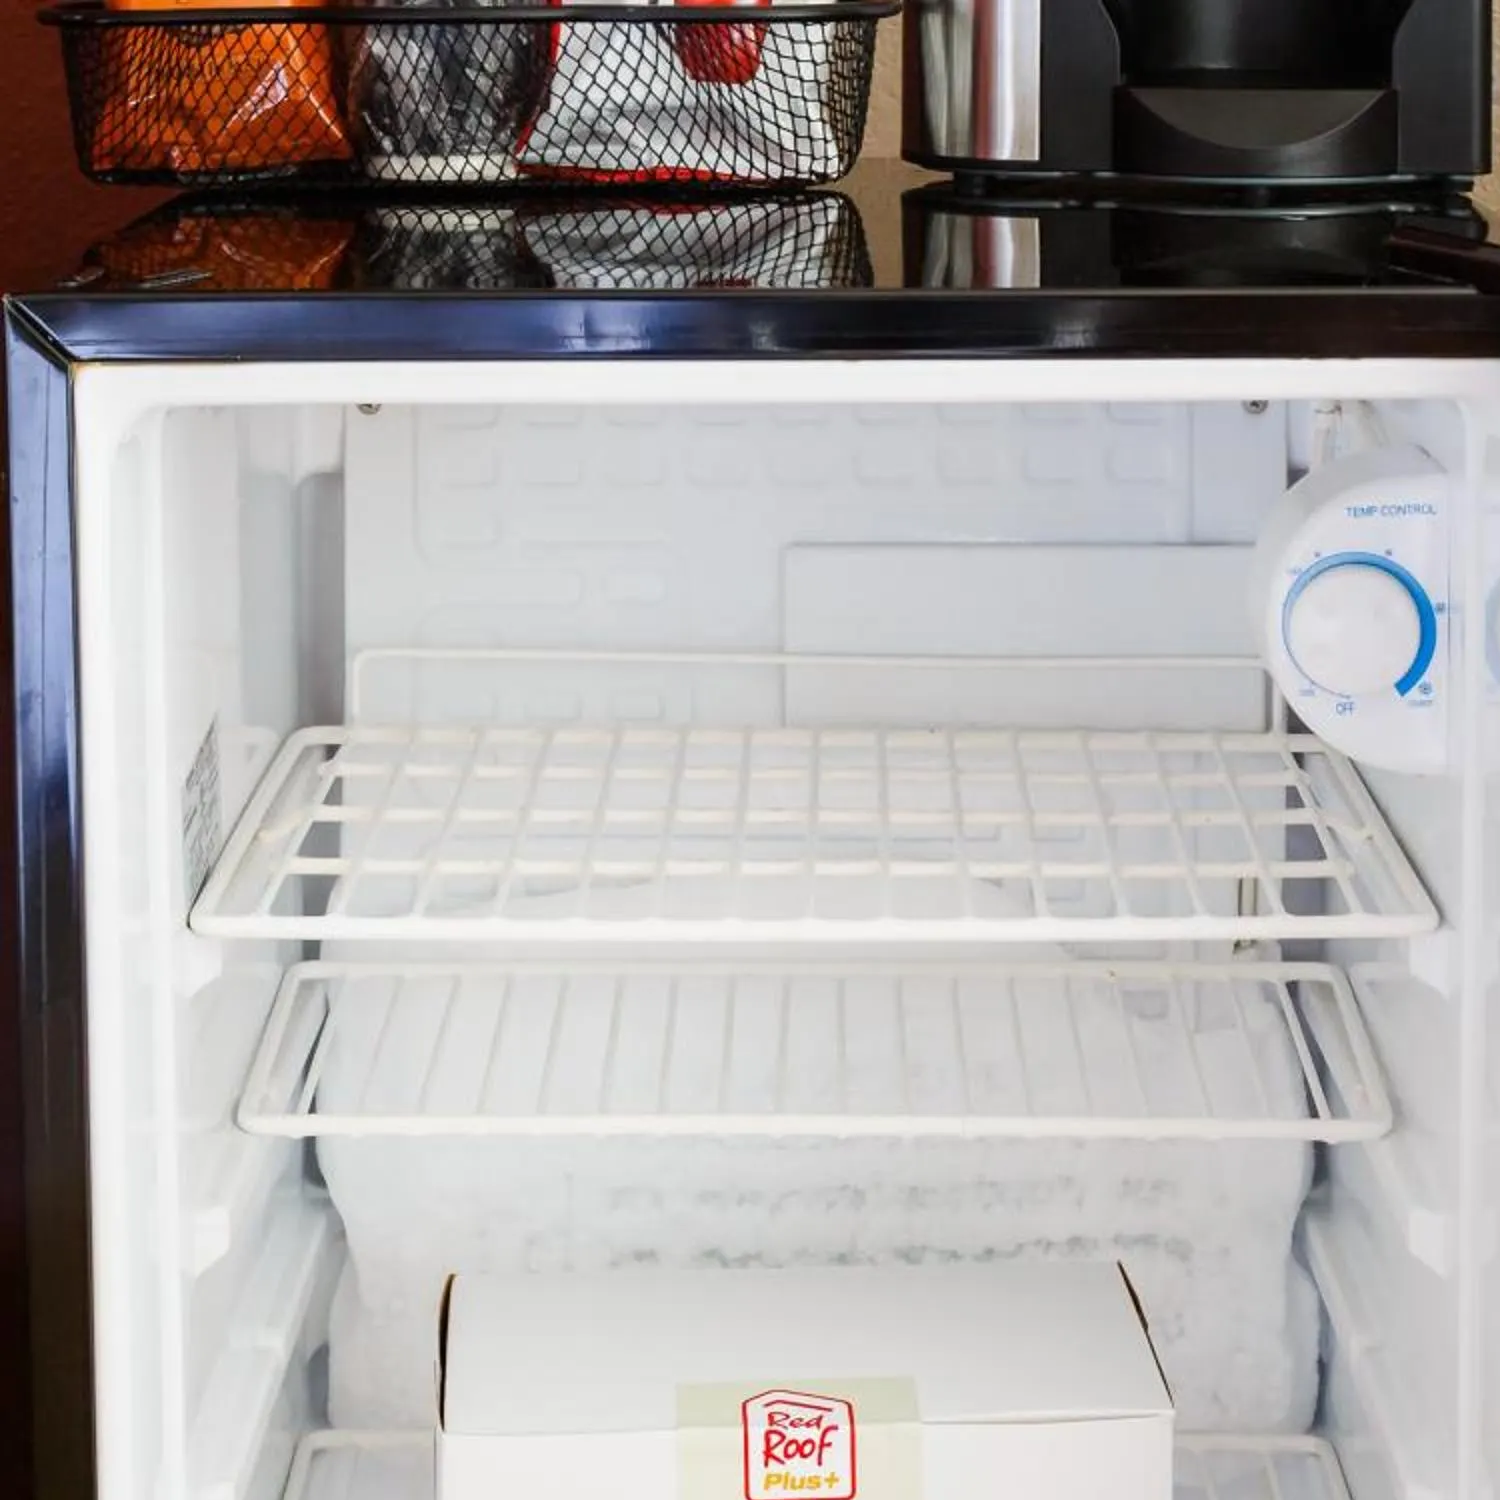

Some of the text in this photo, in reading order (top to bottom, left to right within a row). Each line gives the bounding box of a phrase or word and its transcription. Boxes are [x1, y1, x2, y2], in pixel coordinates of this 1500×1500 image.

[1344, 503, 1437, 518] TEMP CONTROL
[1335, 702, 1356, 715] OFF
[768, 1411, 824, 1430] Red
[763, 1425, 839, 1468] Roof
[763, 1472, 840, 1491] Plus+
